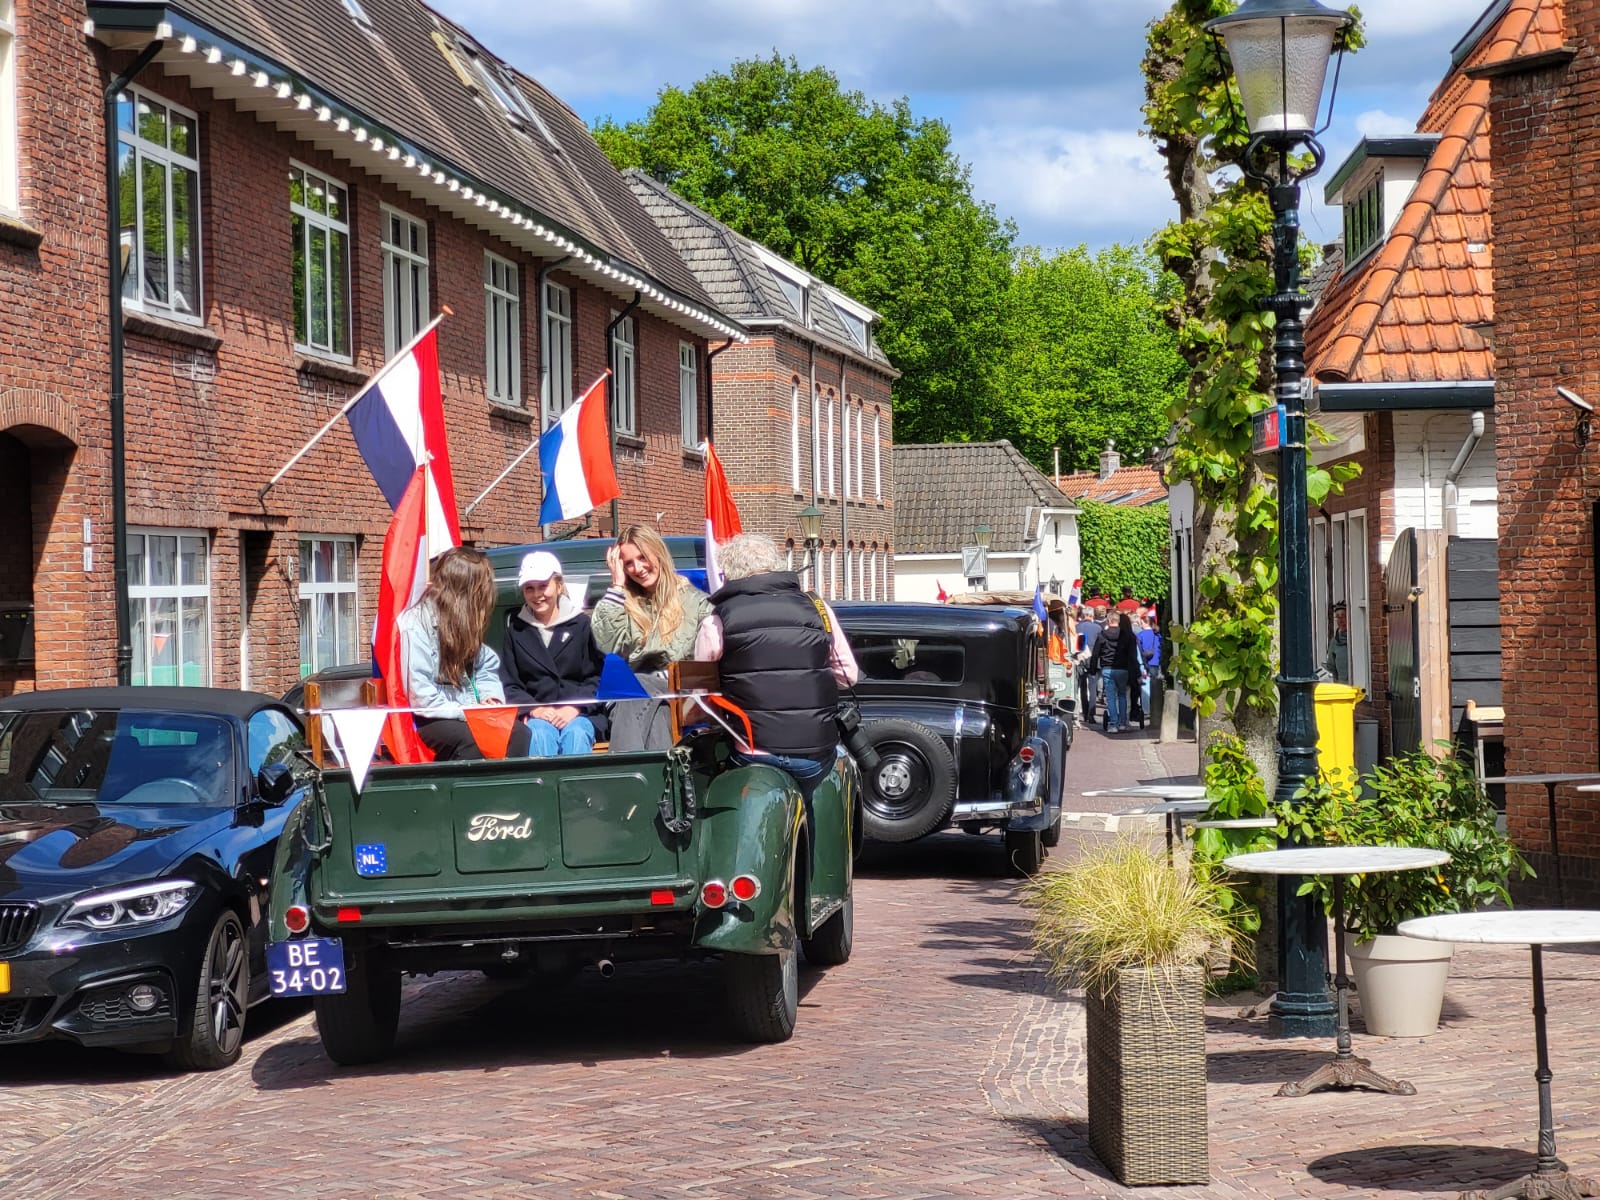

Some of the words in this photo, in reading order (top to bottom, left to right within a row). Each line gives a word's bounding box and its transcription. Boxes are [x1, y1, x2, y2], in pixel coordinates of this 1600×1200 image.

[467, 812, 533, 842] Ford
[362, 854, 379, 866] NL
[288, 943, 320, 967] BE
[272, 968, 343, 993] 34-02
